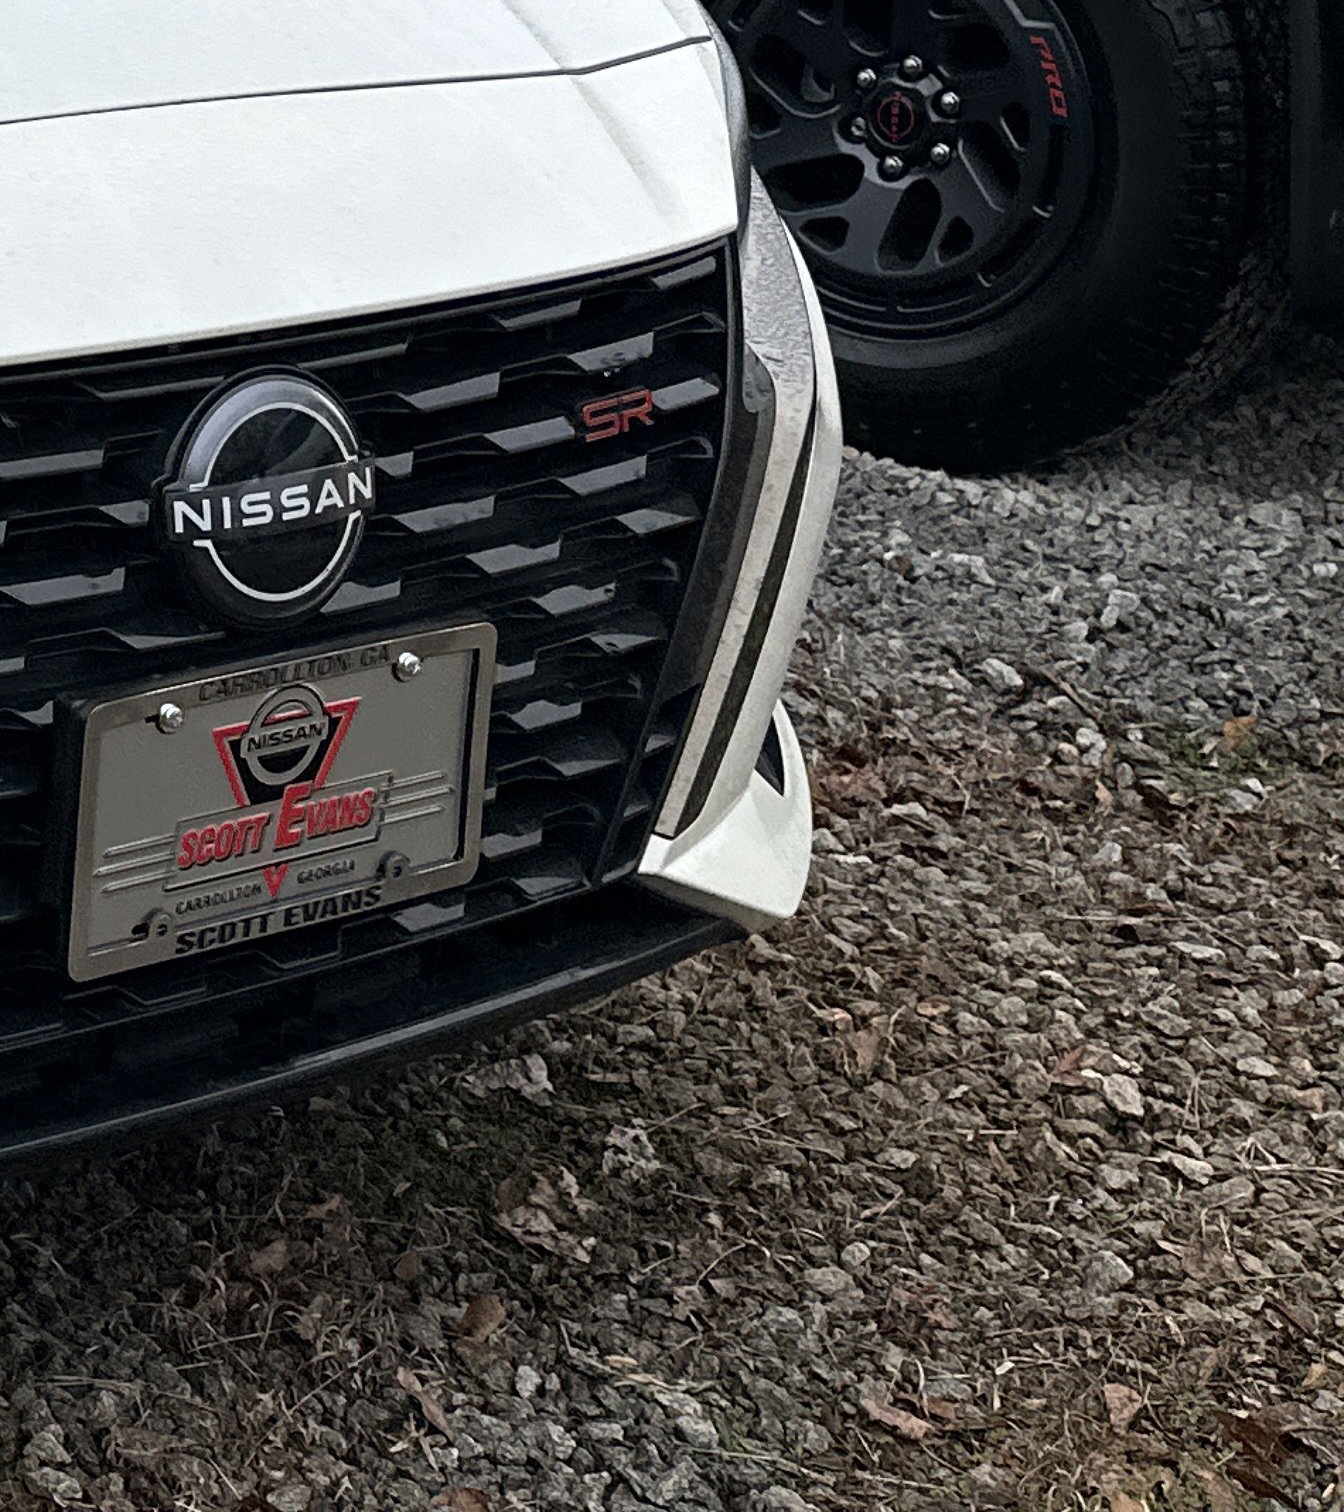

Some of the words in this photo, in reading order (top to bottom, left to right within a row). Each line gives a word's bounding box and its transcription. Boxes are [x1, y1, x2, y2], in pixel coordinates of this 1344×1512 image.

[1029, 35, 1069, 118] PRO
[582, 388, 654, 443] SR
[172, 465, 374, 535] NISSAN
[247, 722, 325, 753] NISSAN
[176, 811, 271, 870] SCOTT
[175, 882, 262, 915] CARROLLTON
[297, 859, 356, 884] GEORGIA
[175, 911, 276, 955] SCOTT
[282, 884, 383, 928] EVANS
